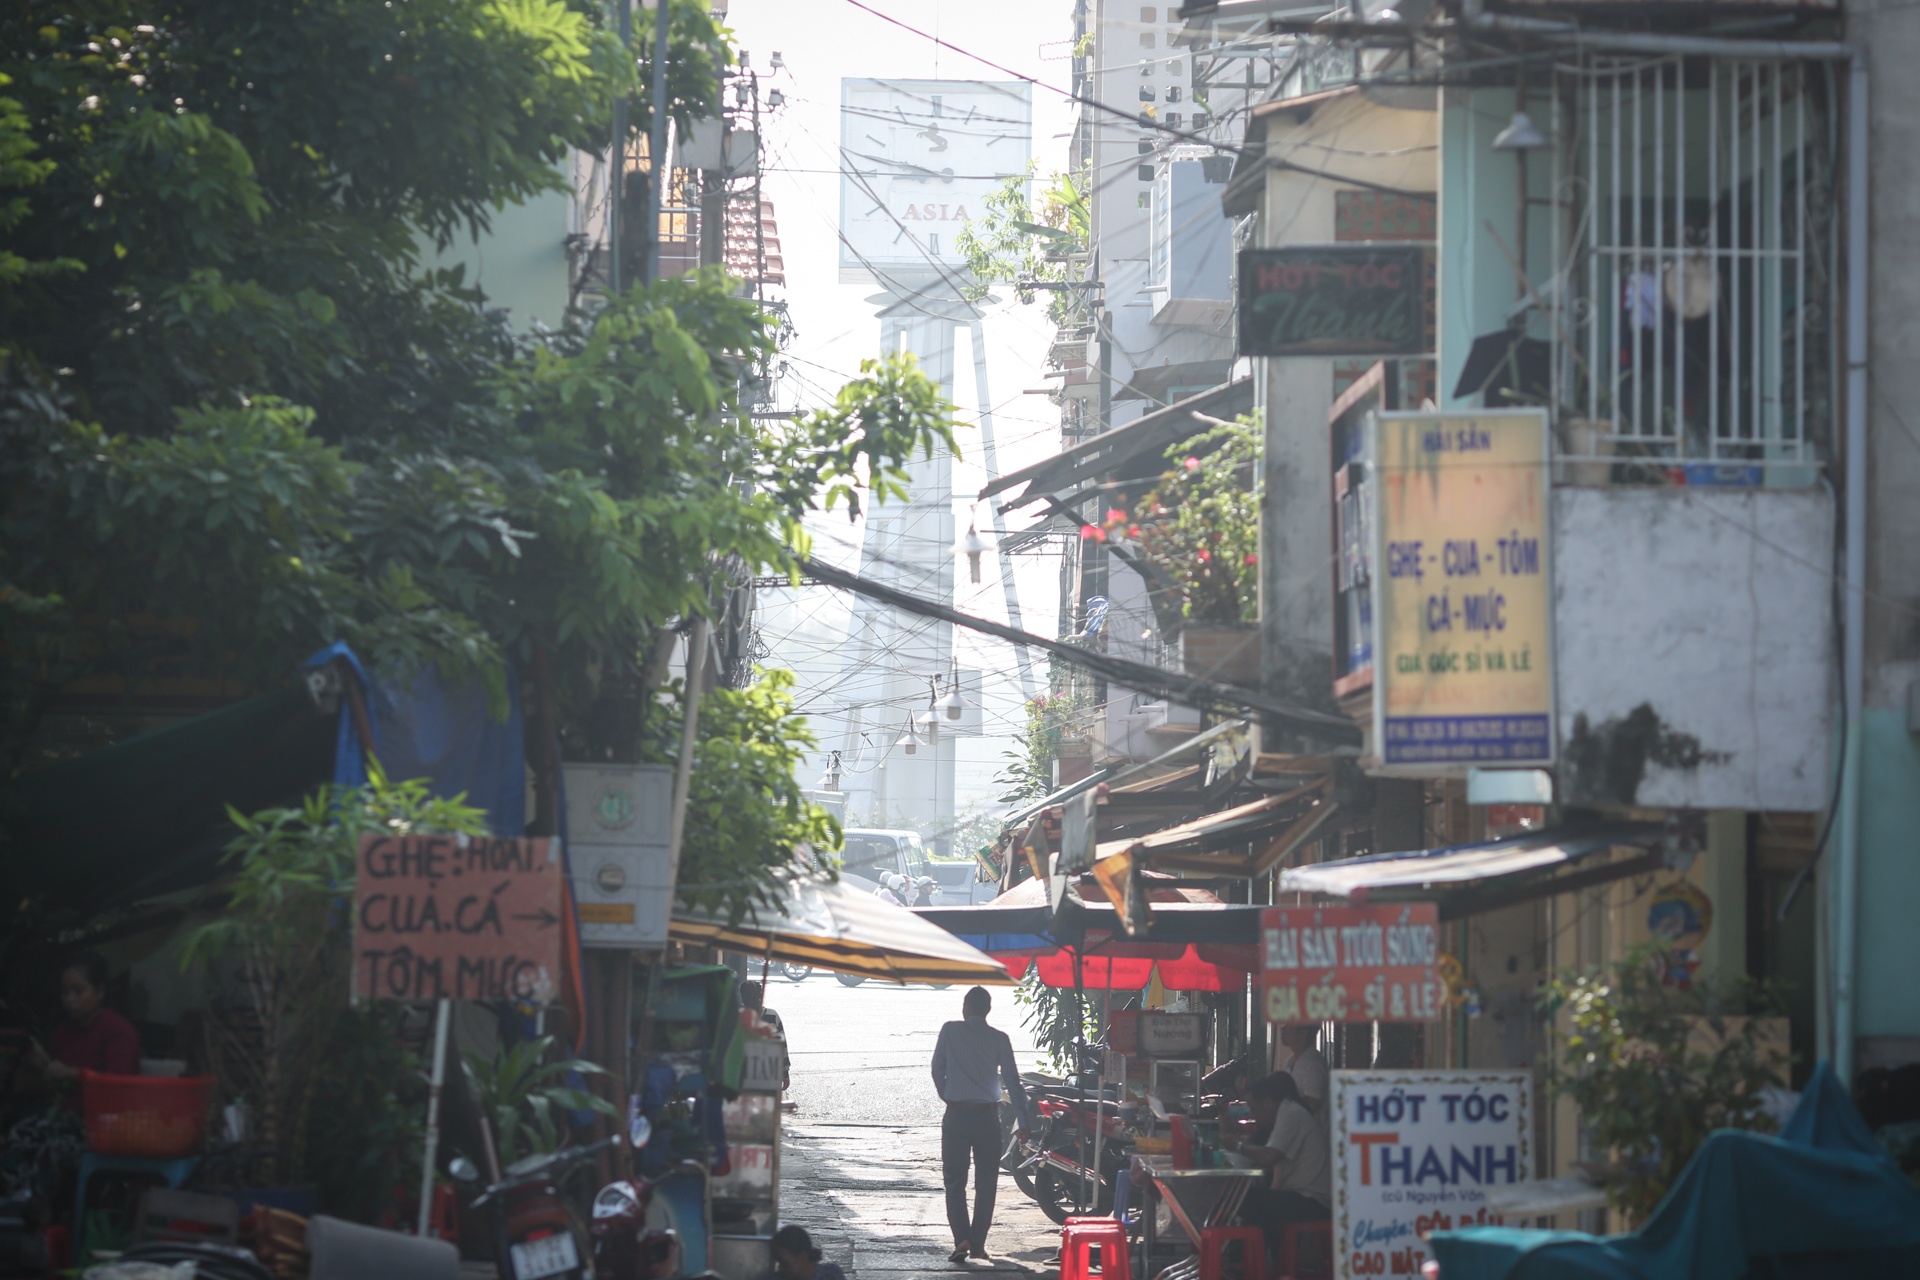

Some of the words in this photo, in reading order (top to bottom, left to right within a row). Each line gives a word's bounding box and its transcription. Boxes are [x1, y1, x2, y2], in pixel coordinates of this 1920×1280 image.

[901, 203, 971, 221] ASIA
[1442, 539, 1480, 577] CUA
[1496, 529, 1539, 576] TÔM
[1263, 912, 1299, 969] HẢI
[1301, 911, 1337, 968] SẢN
[1386, 905, 1436, 966] SỐNG
[1267, 976, 1301, 1020] GIÁ
[1306, 972, 1348, 1020] GỐC
[1356, 1087, 1427, 1124] HỚT
[1440, 1086, 1510, 1124] TÓC
